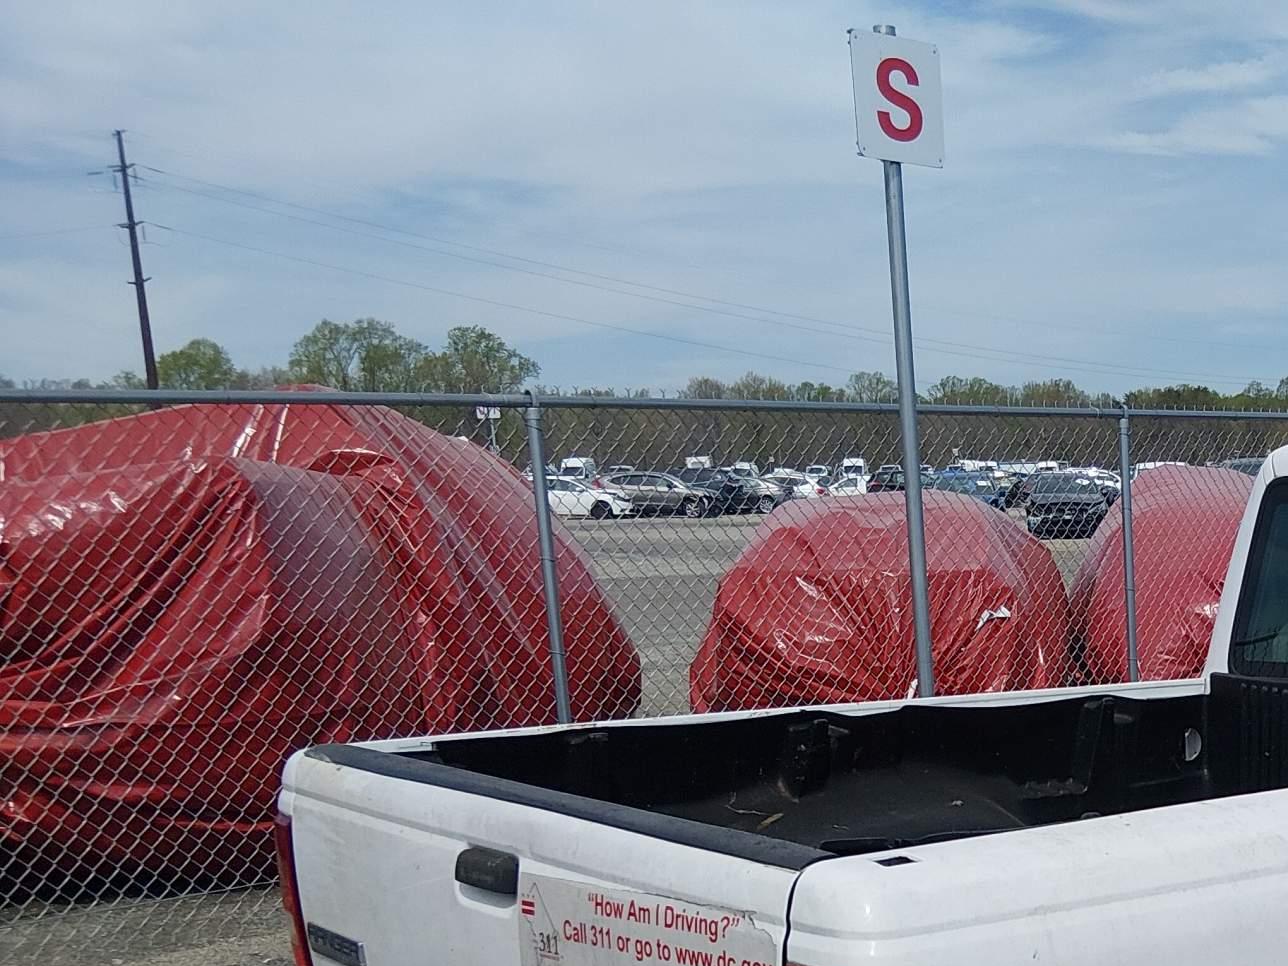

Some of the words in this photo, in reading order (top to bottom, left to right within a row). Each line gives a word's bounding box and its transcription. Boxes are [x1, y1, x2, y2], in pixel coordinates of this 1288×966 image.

[876, 57, 924, 142] S
[627, 899, 651, 925] Am
[656, 904, 660, 926] I
[539, 932, 559, 955] 311
[563, 920, 587, 945] Call
[591, 925, 612, 949] 311
[617, 936, 631, 953] or
[635, 939, 652, 961] go
[657, 939, 671, 961] to
